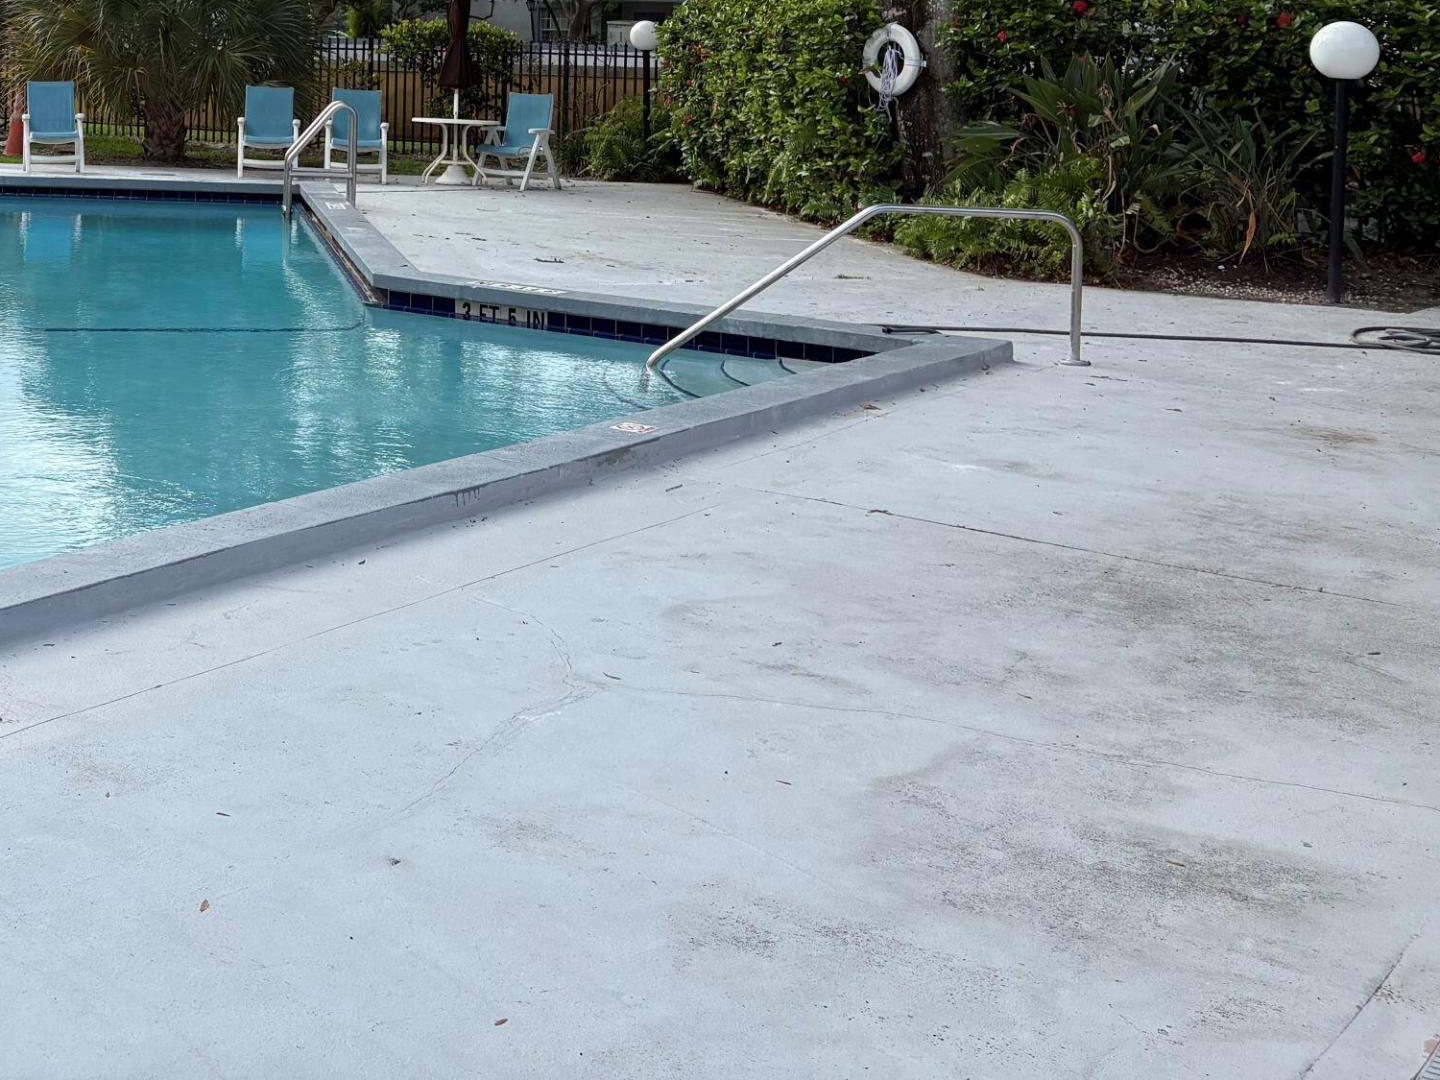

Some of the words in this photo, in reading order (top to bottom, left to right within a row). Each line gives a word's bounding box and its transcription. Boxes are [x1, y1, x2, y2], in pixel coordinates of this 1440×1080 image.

[462, 302, 471, 320] 3
[479, 304, 500, 323] FT
[508, 308, 517, 326] 5
[526, 310, 545, 330] IN
